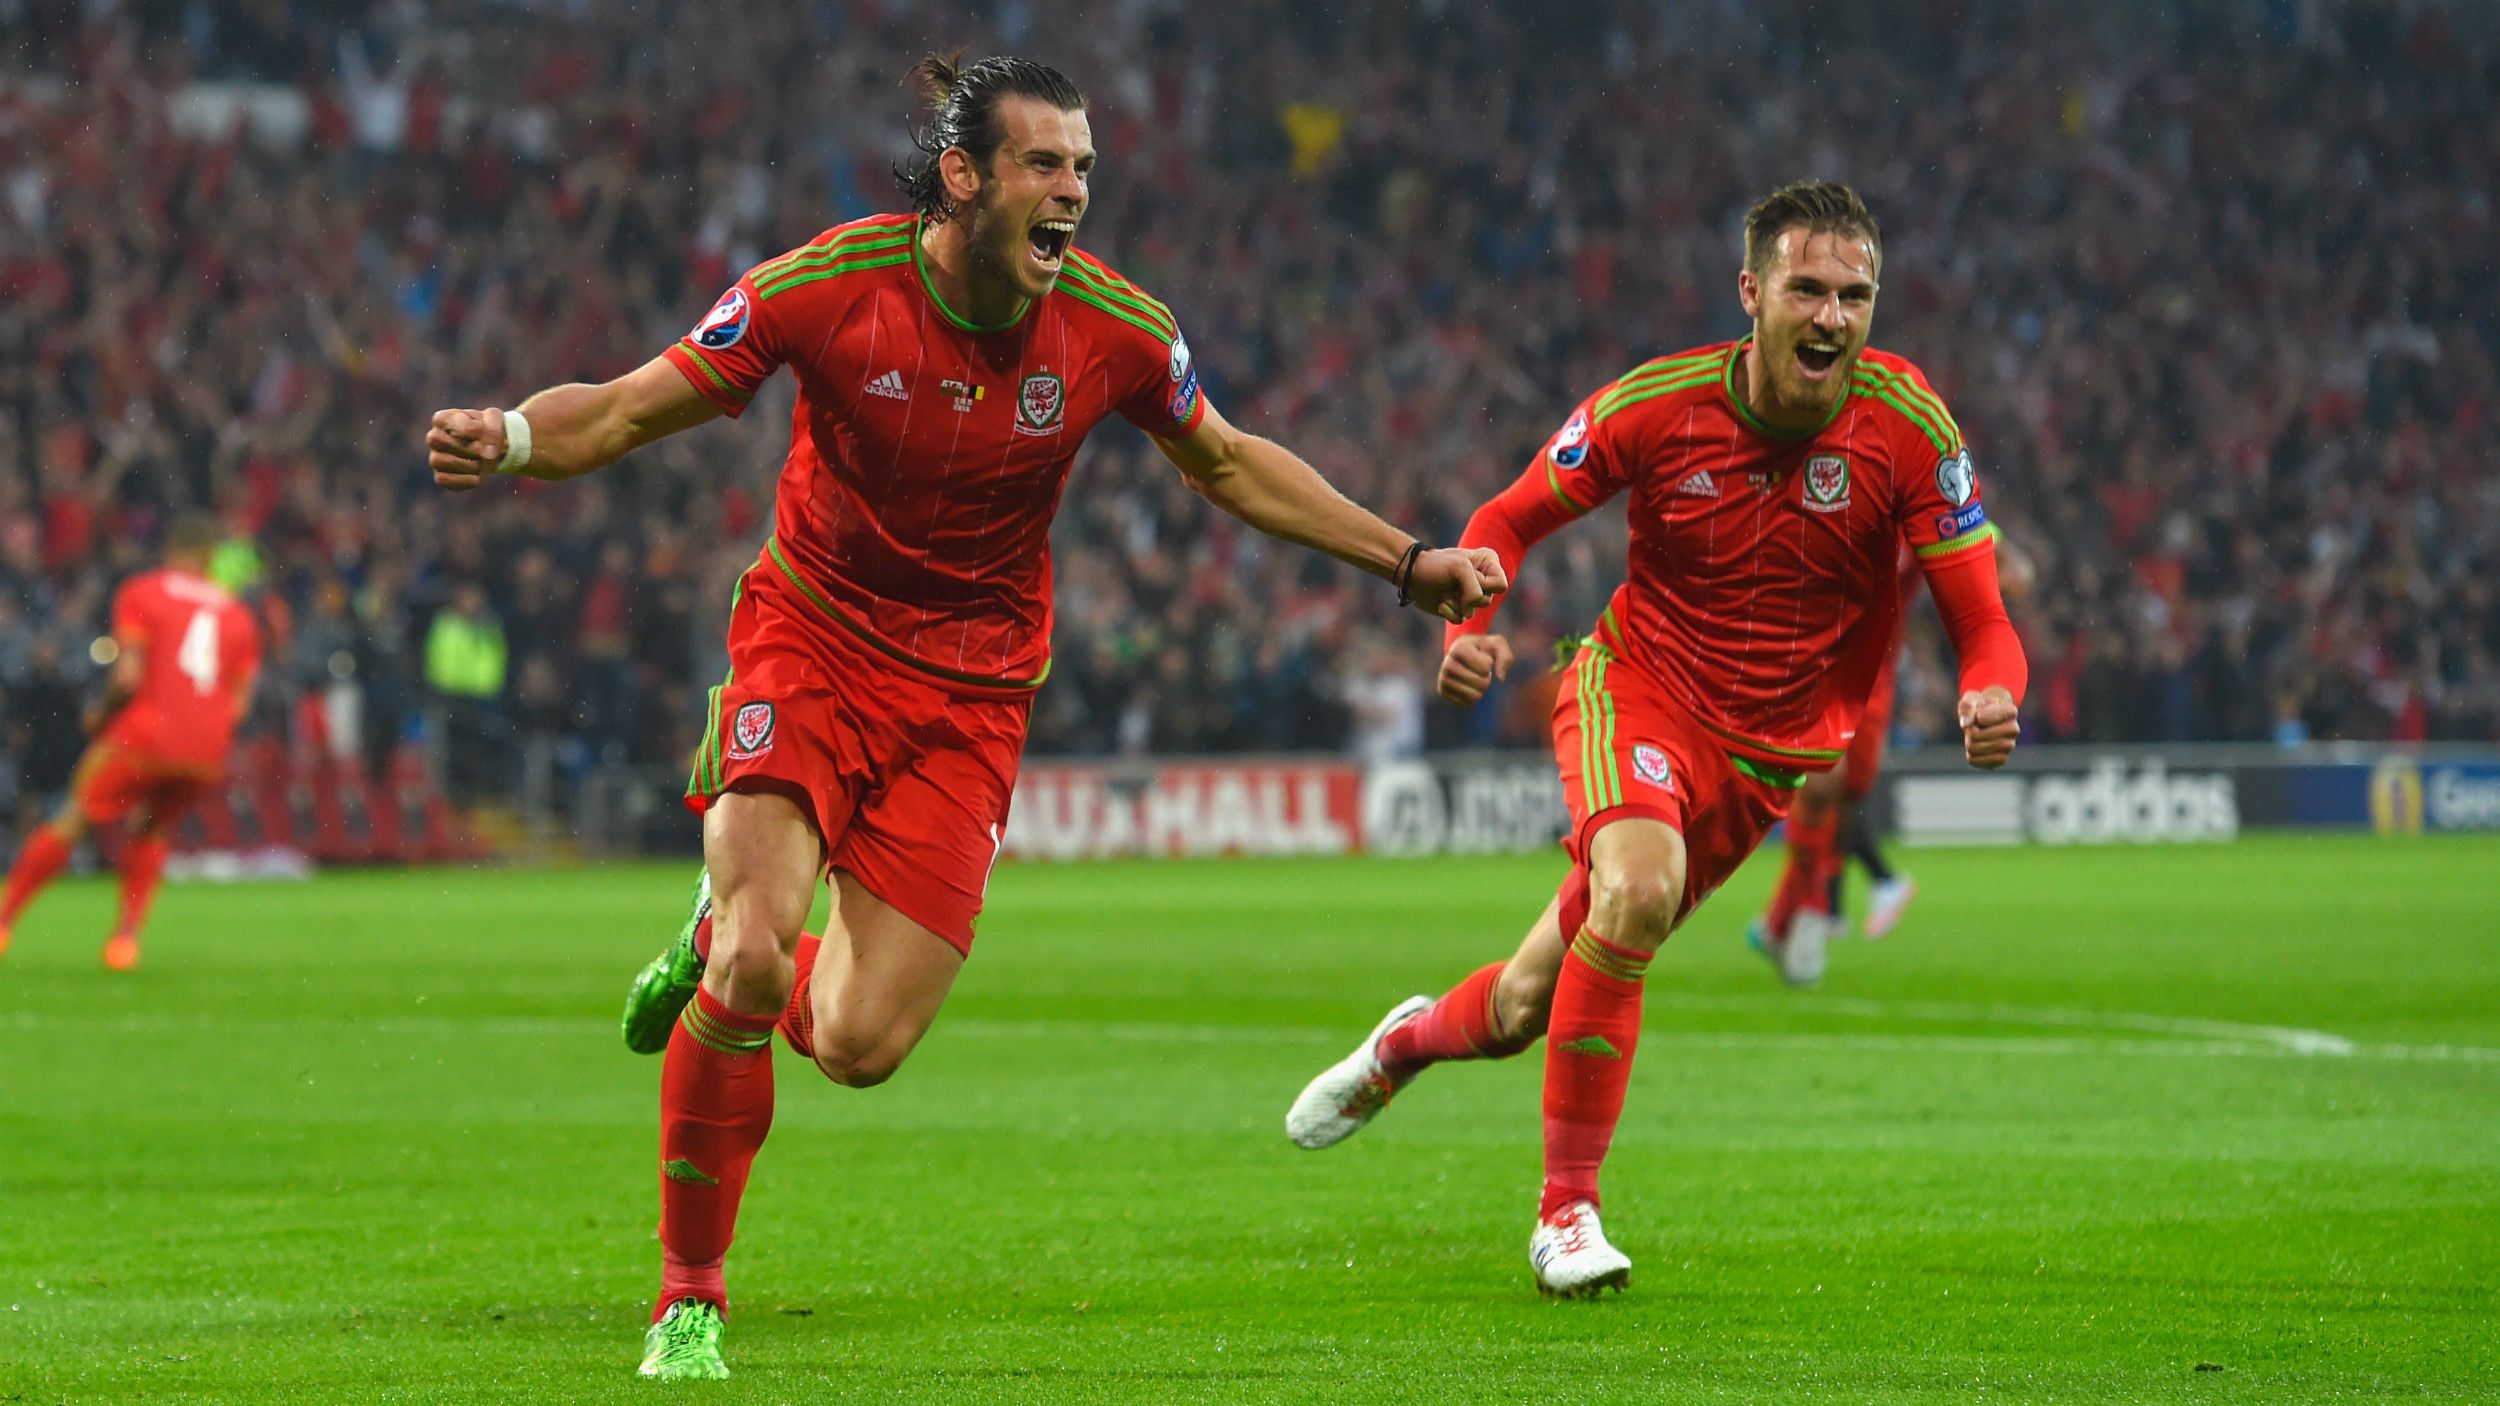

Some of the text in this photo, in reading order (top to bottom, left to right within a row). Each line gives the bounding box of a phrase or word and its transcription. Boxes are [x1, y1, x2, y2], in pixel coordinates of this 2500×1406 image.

[864, 384, 909, 401] adidas
[178, 610, 219, 695] 4
[999, 770, 1352, 859] AUXHALL
[2033, 755, 2239, 845] adidas
